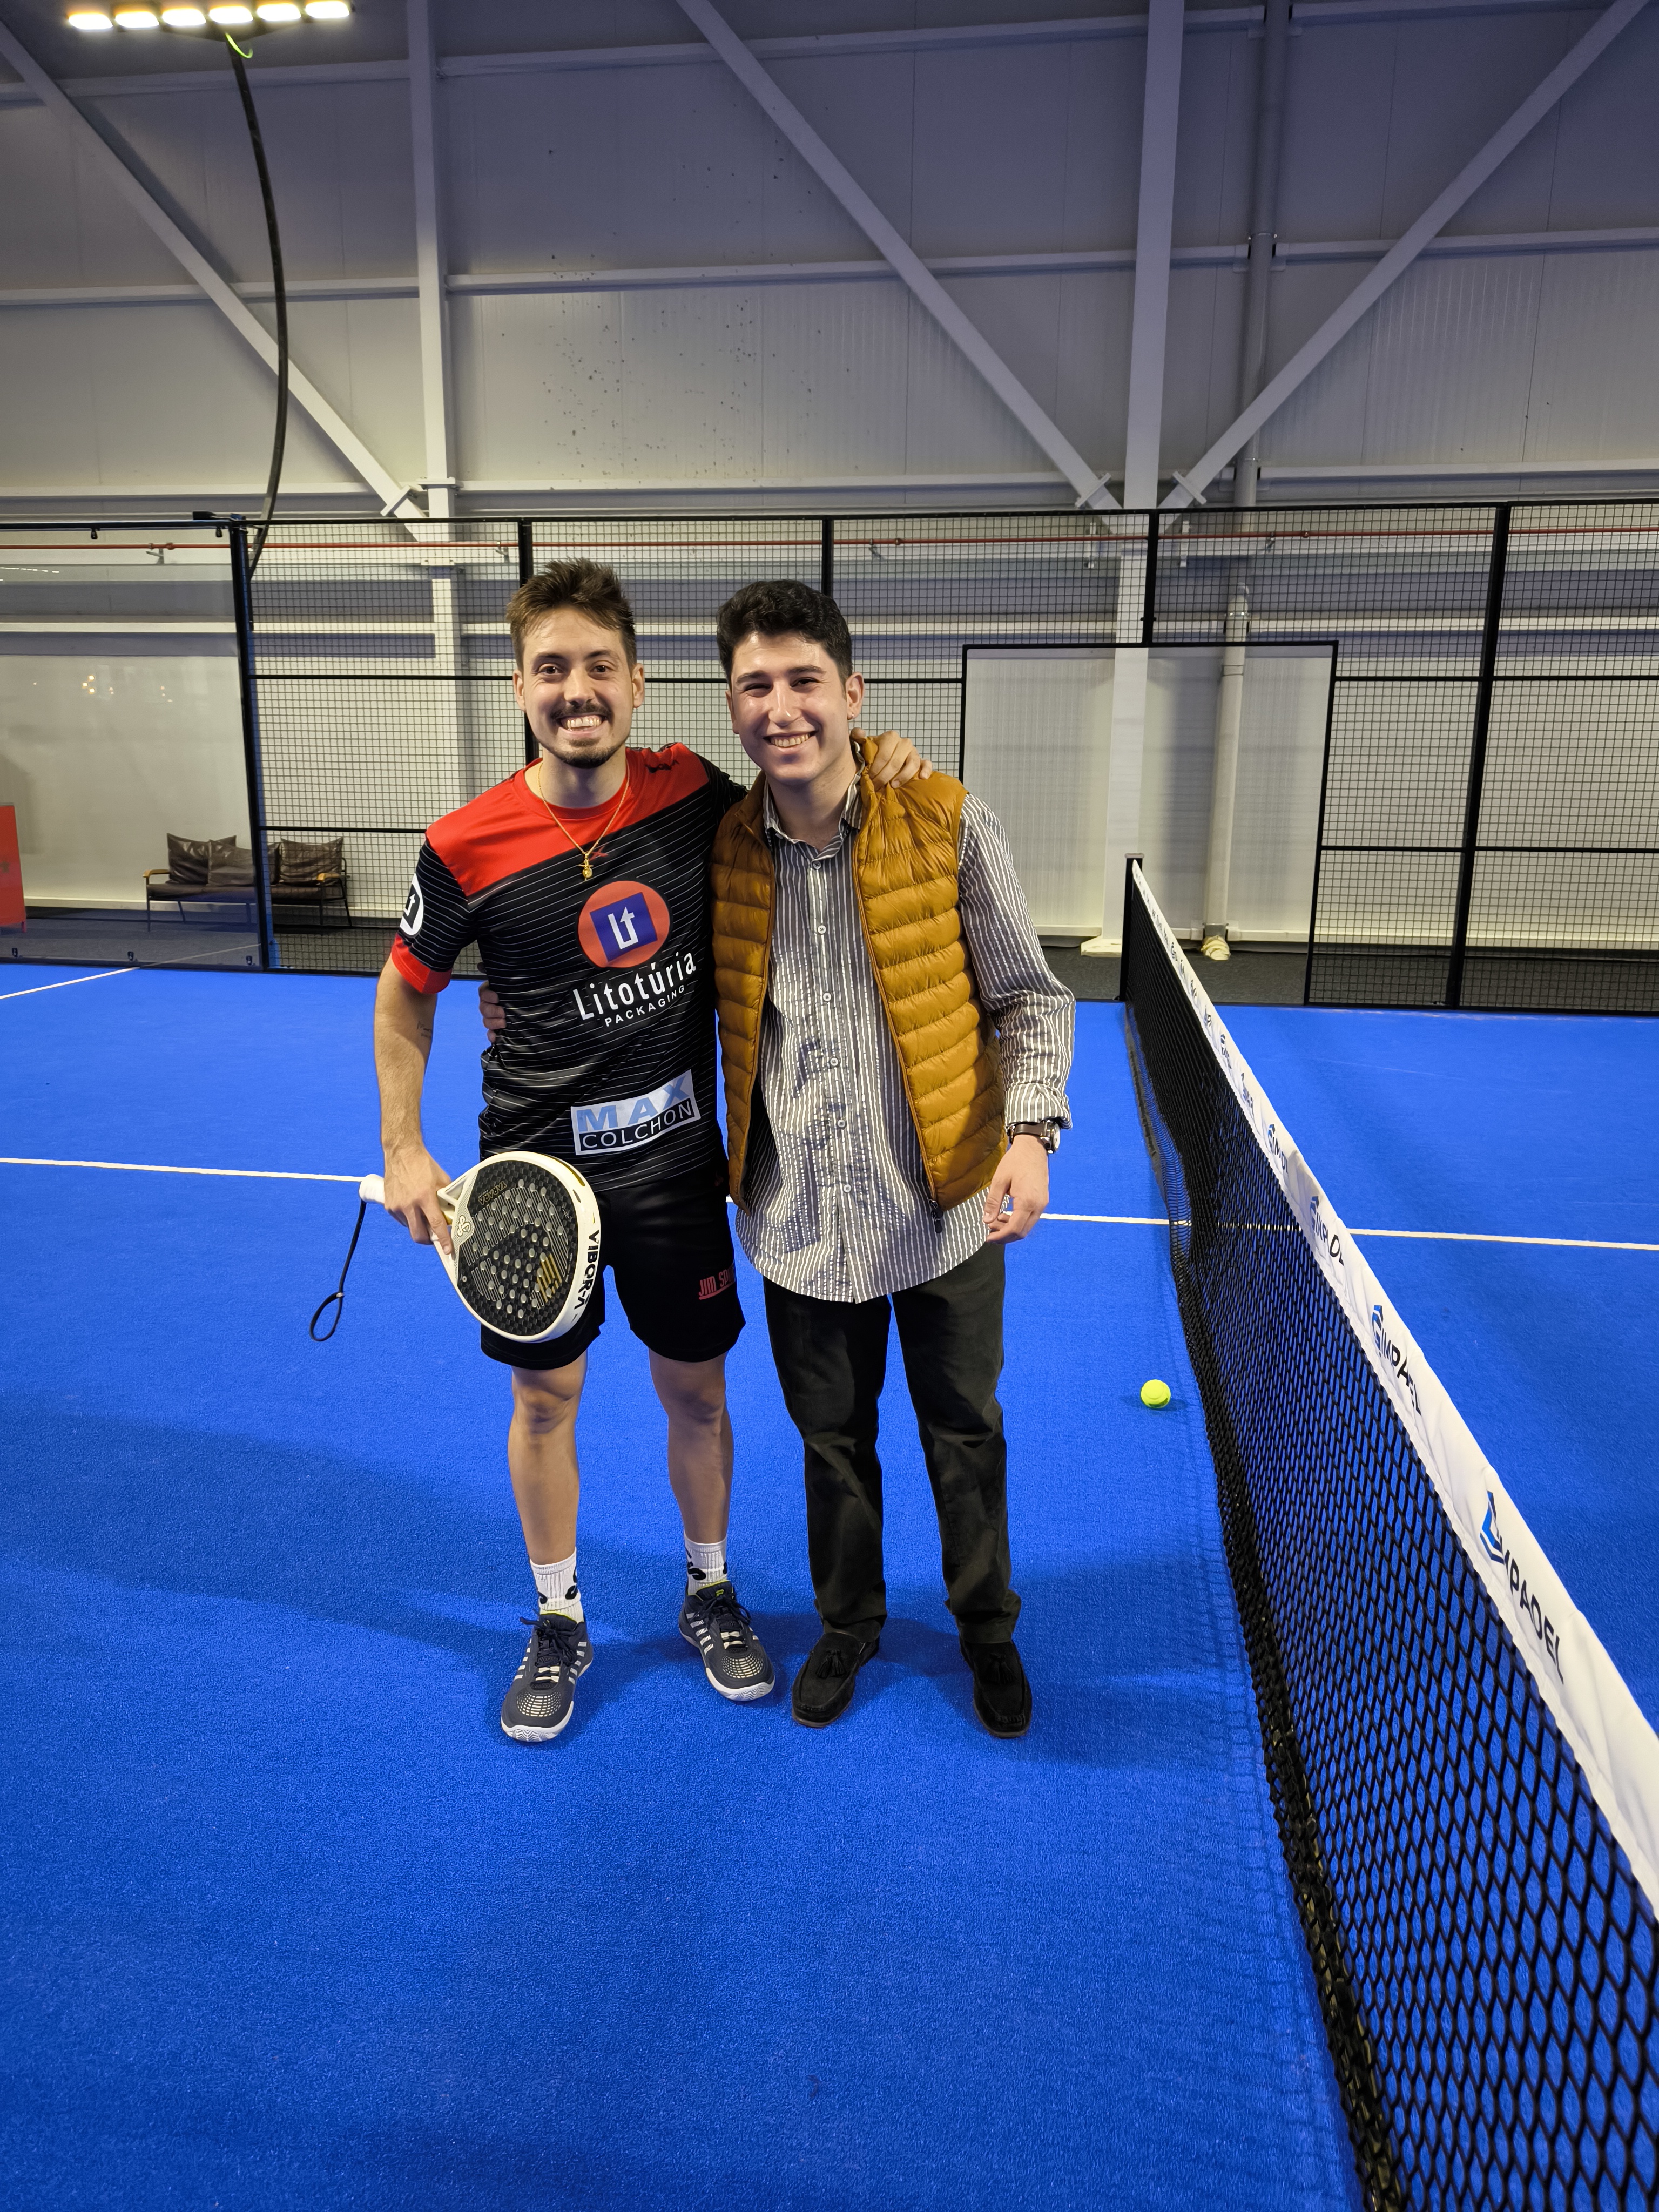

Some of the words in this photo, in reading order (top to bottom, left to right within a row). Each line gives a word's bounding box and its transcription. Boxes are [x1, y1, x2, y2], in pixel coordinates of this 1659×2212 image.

[572, 952, 697, 1021] Litotúria
[604, 984, 685, 1027] PACKAGING
[576, 1075, 690, 1132] MAX
[582, 1101, 692, 1148] COLCHON
[698, 1276, 717, 1296] JIM
